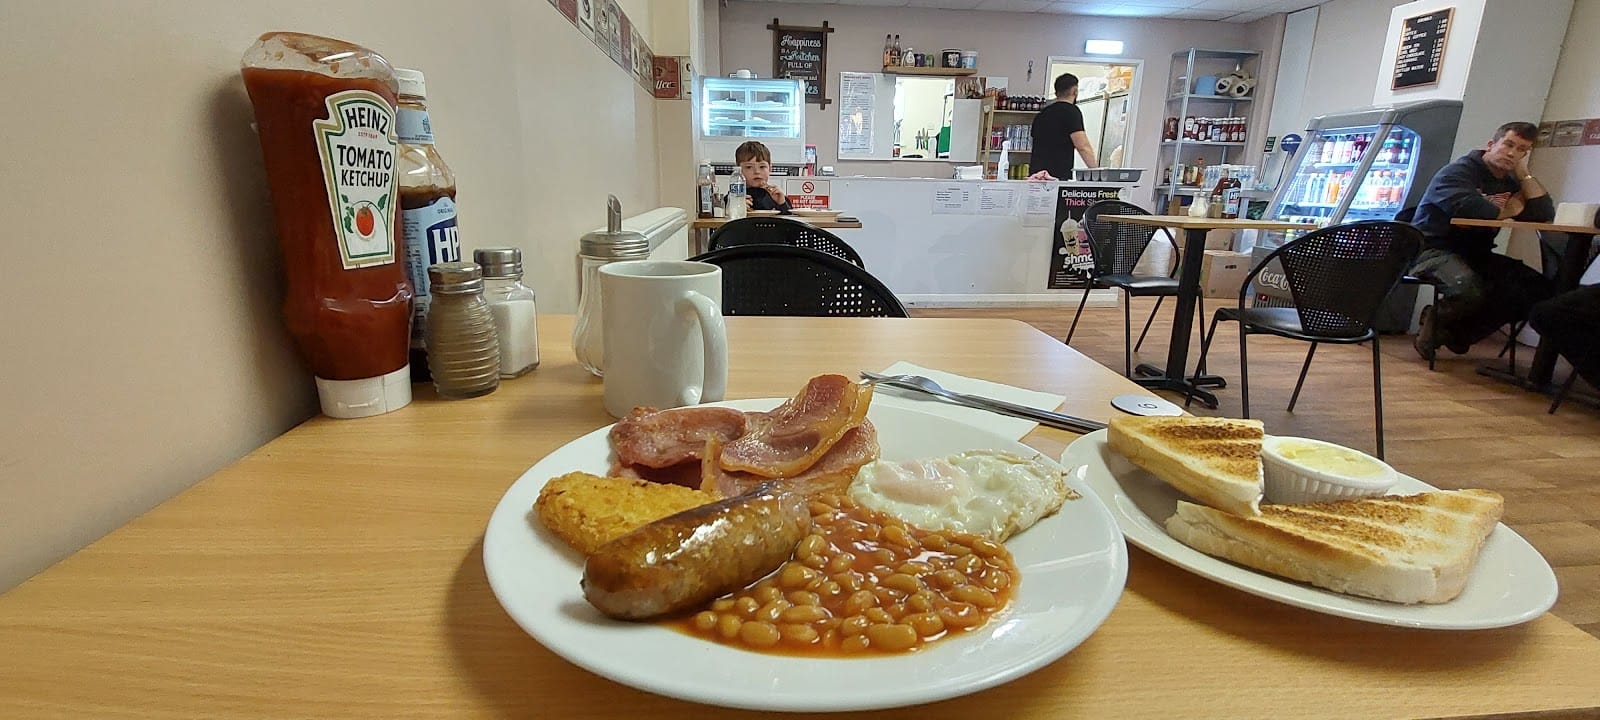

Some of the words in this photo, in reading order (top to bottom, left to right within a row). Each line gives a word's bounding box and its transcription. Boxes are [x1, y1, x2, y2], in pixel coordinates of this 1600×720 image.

[780, 35, 821, 49] Happiness
[345, 107, 388, 136] HEINZ
[336, 144, 392, 170] TOMATO
[341, 169, 390, 188] KETCHUP
[1061, 190, 1097, 198] Delicious
[1065, 198, 1085, 206] Thick
[431, 225, 461, 265] HP
